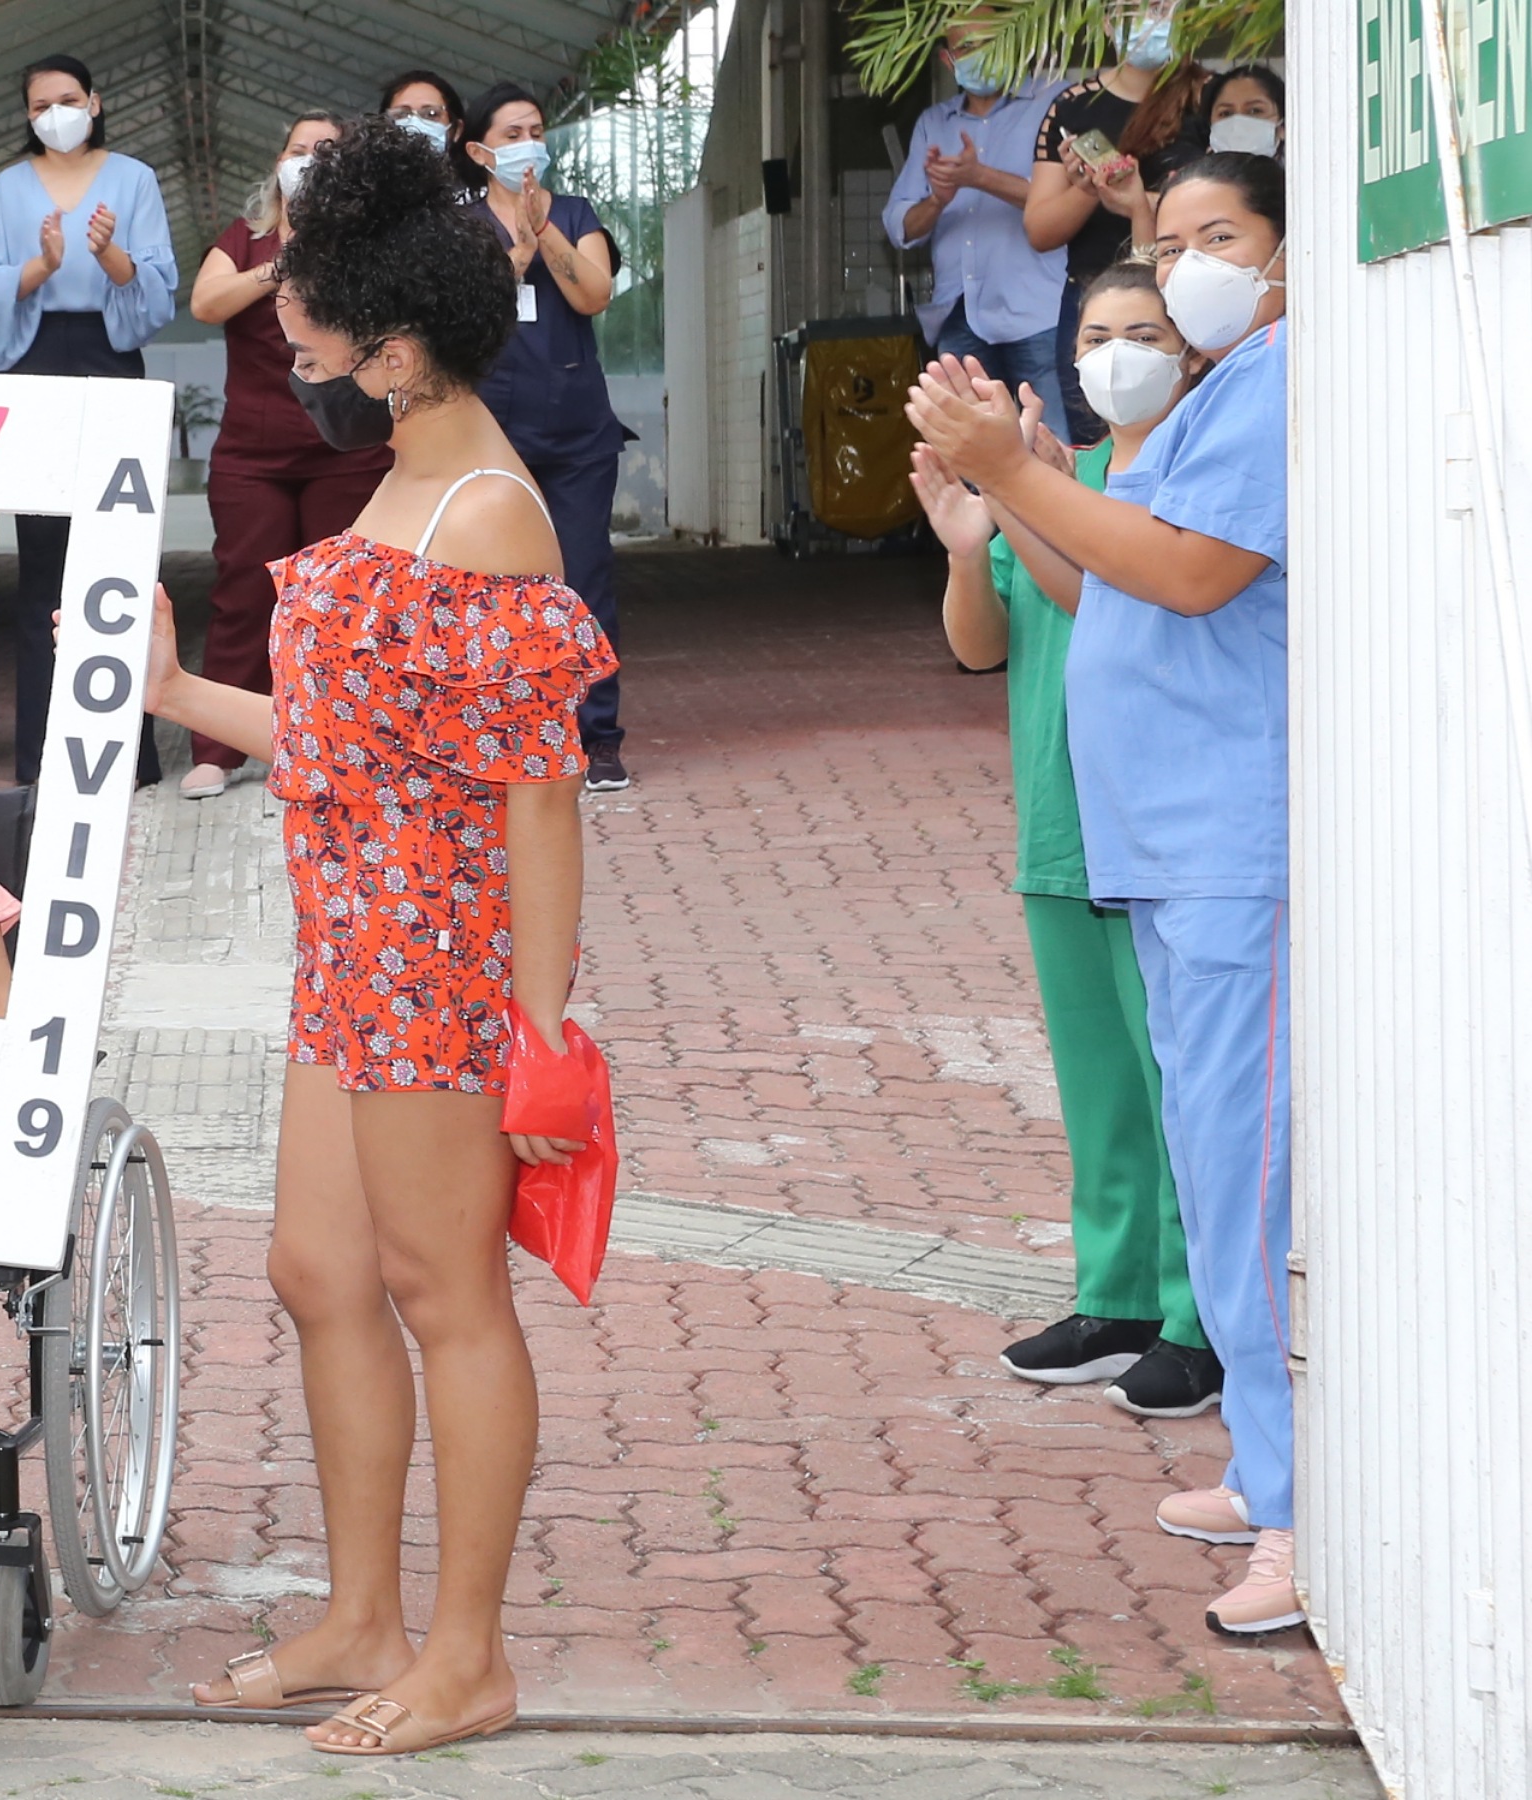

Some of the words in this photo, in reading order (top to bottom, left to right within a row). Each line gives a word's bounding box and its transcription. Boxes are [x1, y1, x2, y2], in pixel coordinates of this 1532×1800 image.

[95, 458, 156, 514] A
[43, 577, 139, 959] COVID
[13, 1016, 66, 1158] 19
